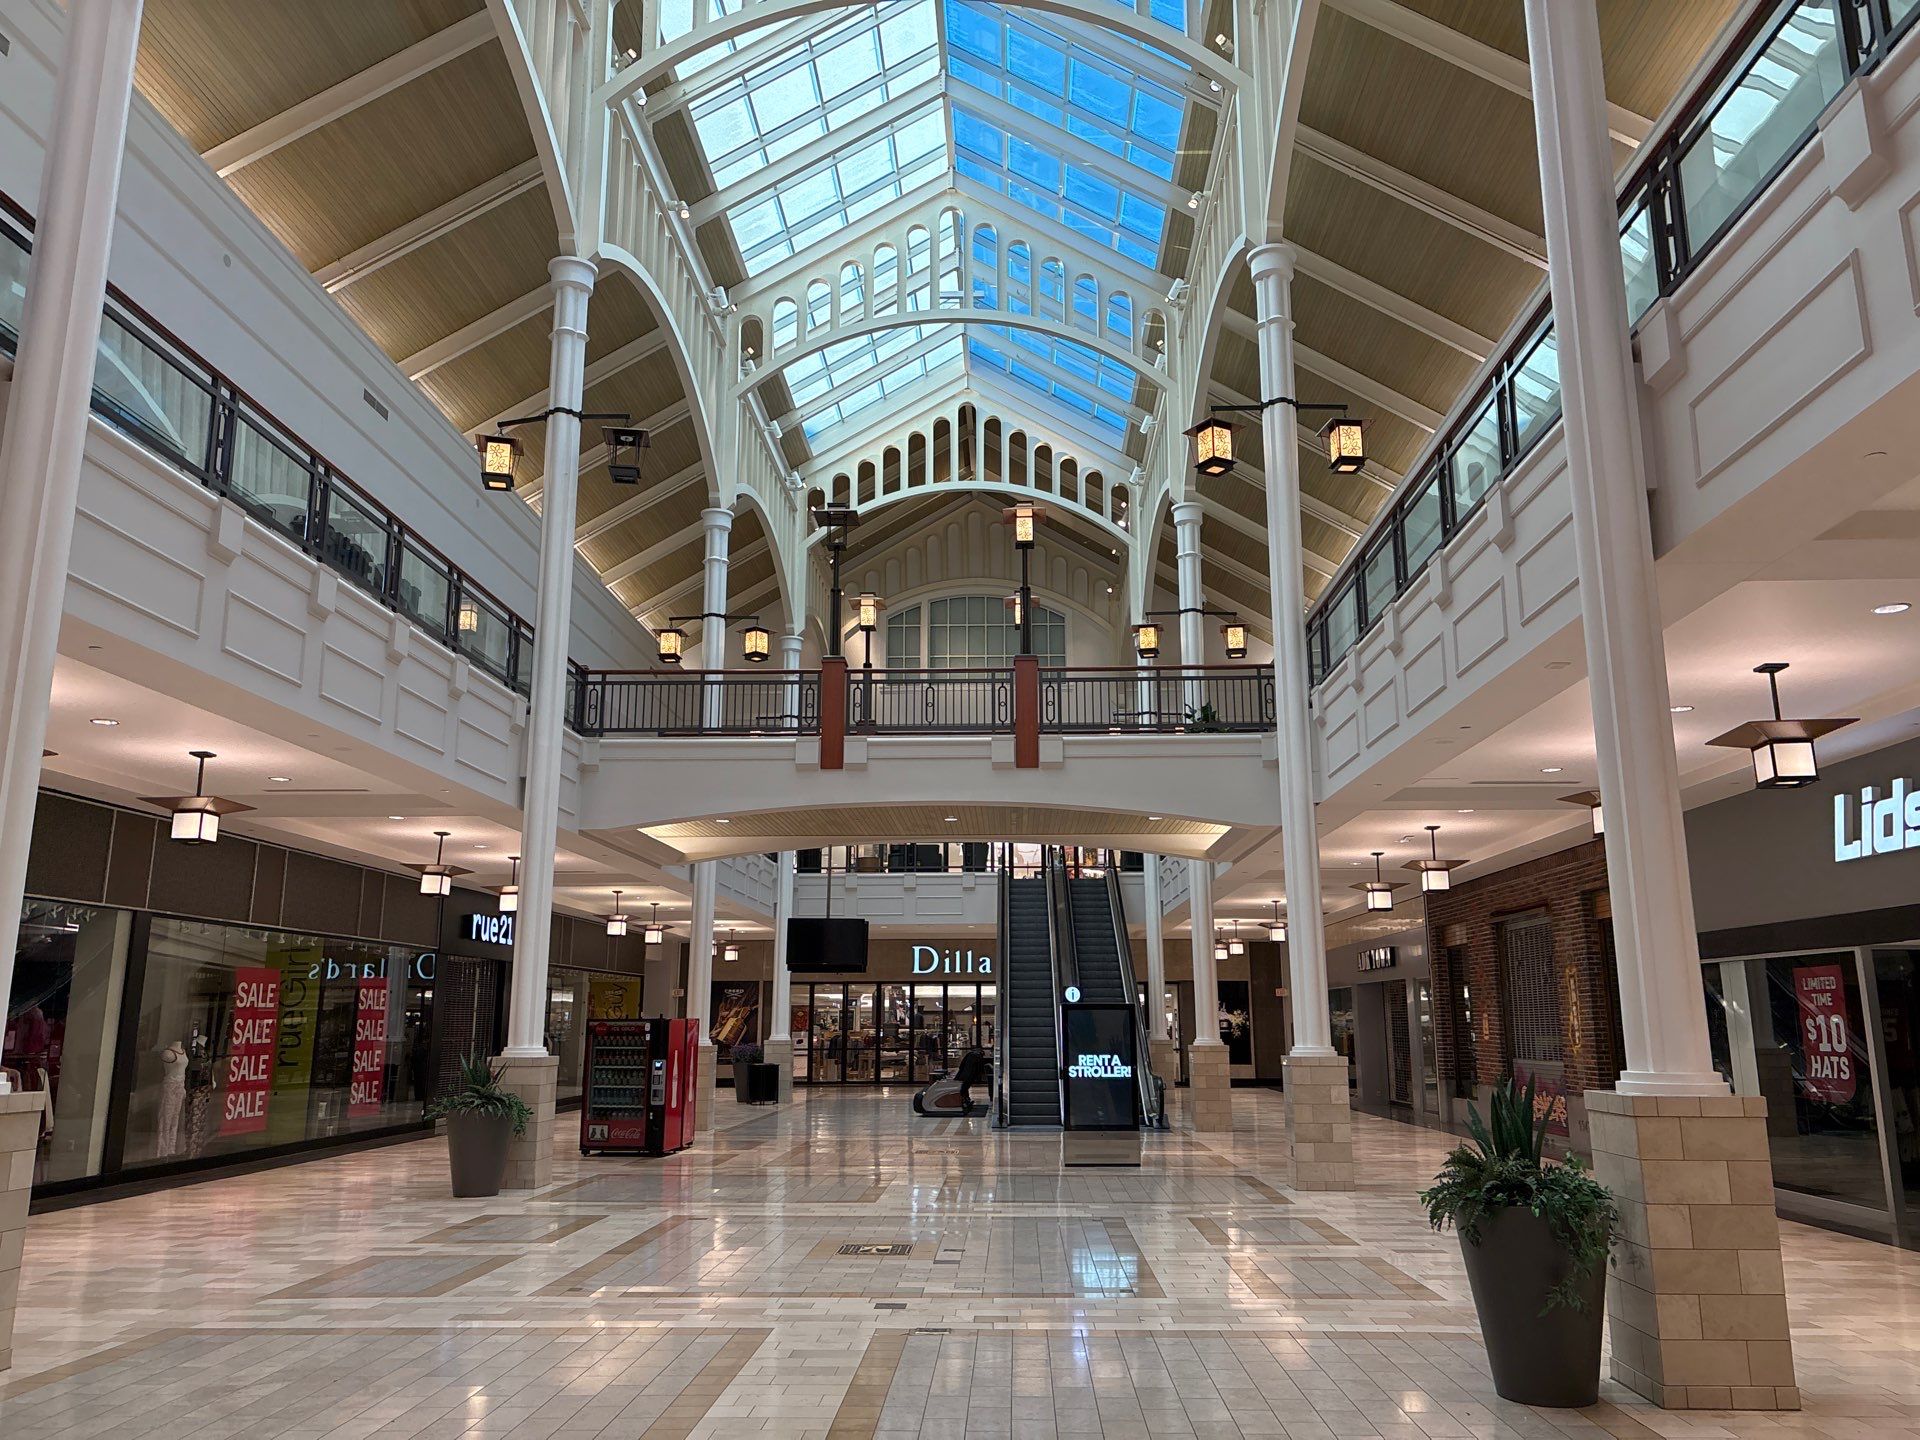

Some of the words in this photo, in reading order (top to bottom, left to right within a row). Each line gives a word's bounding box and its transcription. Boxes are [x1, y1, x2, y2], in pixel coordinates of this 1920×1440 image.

[1834, 777, 1920, 862] Lids
[472, 913, 513, 945] rue21
[912, 945, 992, 974] Dilla
[236, 981, 277, 1009] SALE
[1803, 976, 1836, 991] LIMITED
[358, 988, 387, 1010] SALE
[1811, 993, 1832, 1006] TIME
[232, 1018, 272, 1045] SALE
[355, 1019, 384, 1041] SALE
[1805, 1013, 1847, 1053] $10
[229, 1054, 269, 1083] SALE
[352, 1049, 382, 1073] SALE
[1068, 1065, 1132, 1078] STROLLER!
[1078, 1054, 1111, 1066] RENT
[1111, 1054, 1121, 1066] A
[1811, 1055, 1850, 1080] HATS
[350, 1080, 379, 1105] SALE
[225, 1090, 266, 1121] SALE
